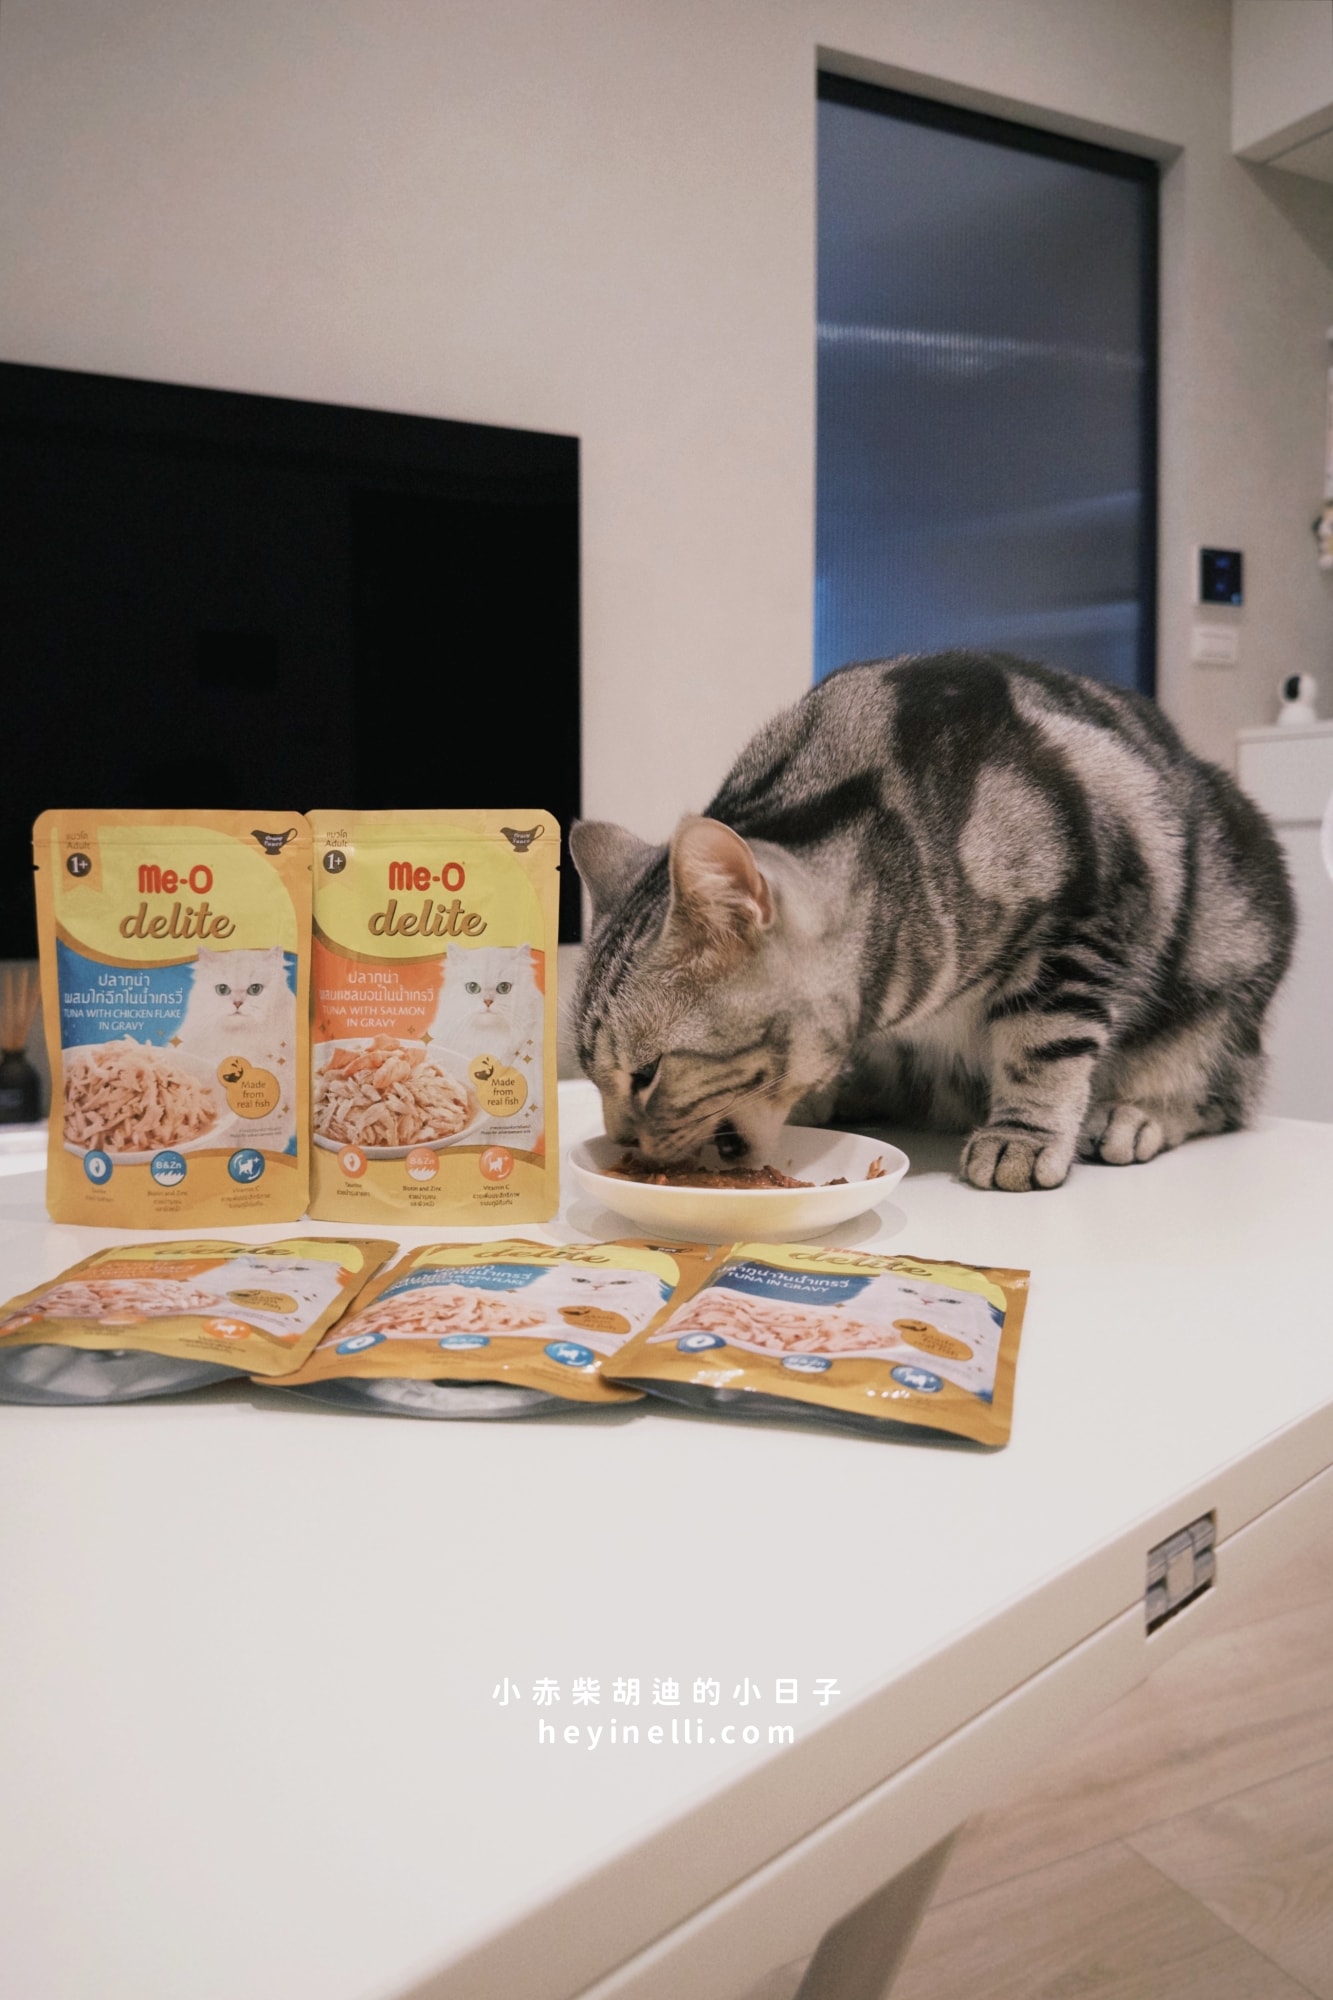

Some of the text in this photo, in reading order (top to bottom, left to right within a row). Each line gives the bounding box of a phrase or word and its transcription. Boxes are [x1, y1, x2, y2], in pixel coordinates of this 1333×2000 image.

[70, 856, 88, 873] 1+
[327, 853, 344, 870] 1+
[138, 864, 213, 894] Me-O
[388, 861, 465, 892] Me-O
[118, 902, 236, 939] delite
[367, 899, 488, 937] delite
[63, 1008, 181, 1019] TUNA WITH CHICKEN FLAKE
[322, 1005, 426, 1016] TUNA WITH SALMON
[99, 1021, 144, 1031] IN GRAVY
[346, 1018, 397, 1028] IN GRAVY
[241, 1080, 266, 1089] Made
[491, 1077, 516, 1087] Made
[243, 1090, 264, 1099] from
[493, 1087, 514, 1096] from
[237, 1099, 271, 1109] real fish
[487, 1096, 519, 1106] real fish
[155, 1161, 182, 1169] B&Zn
[473, 1247, 611, 1264] delite
[788, 1251, 933, 1277] delite
[728, 1271, 830, 1293] TUNA IN GRAVY
